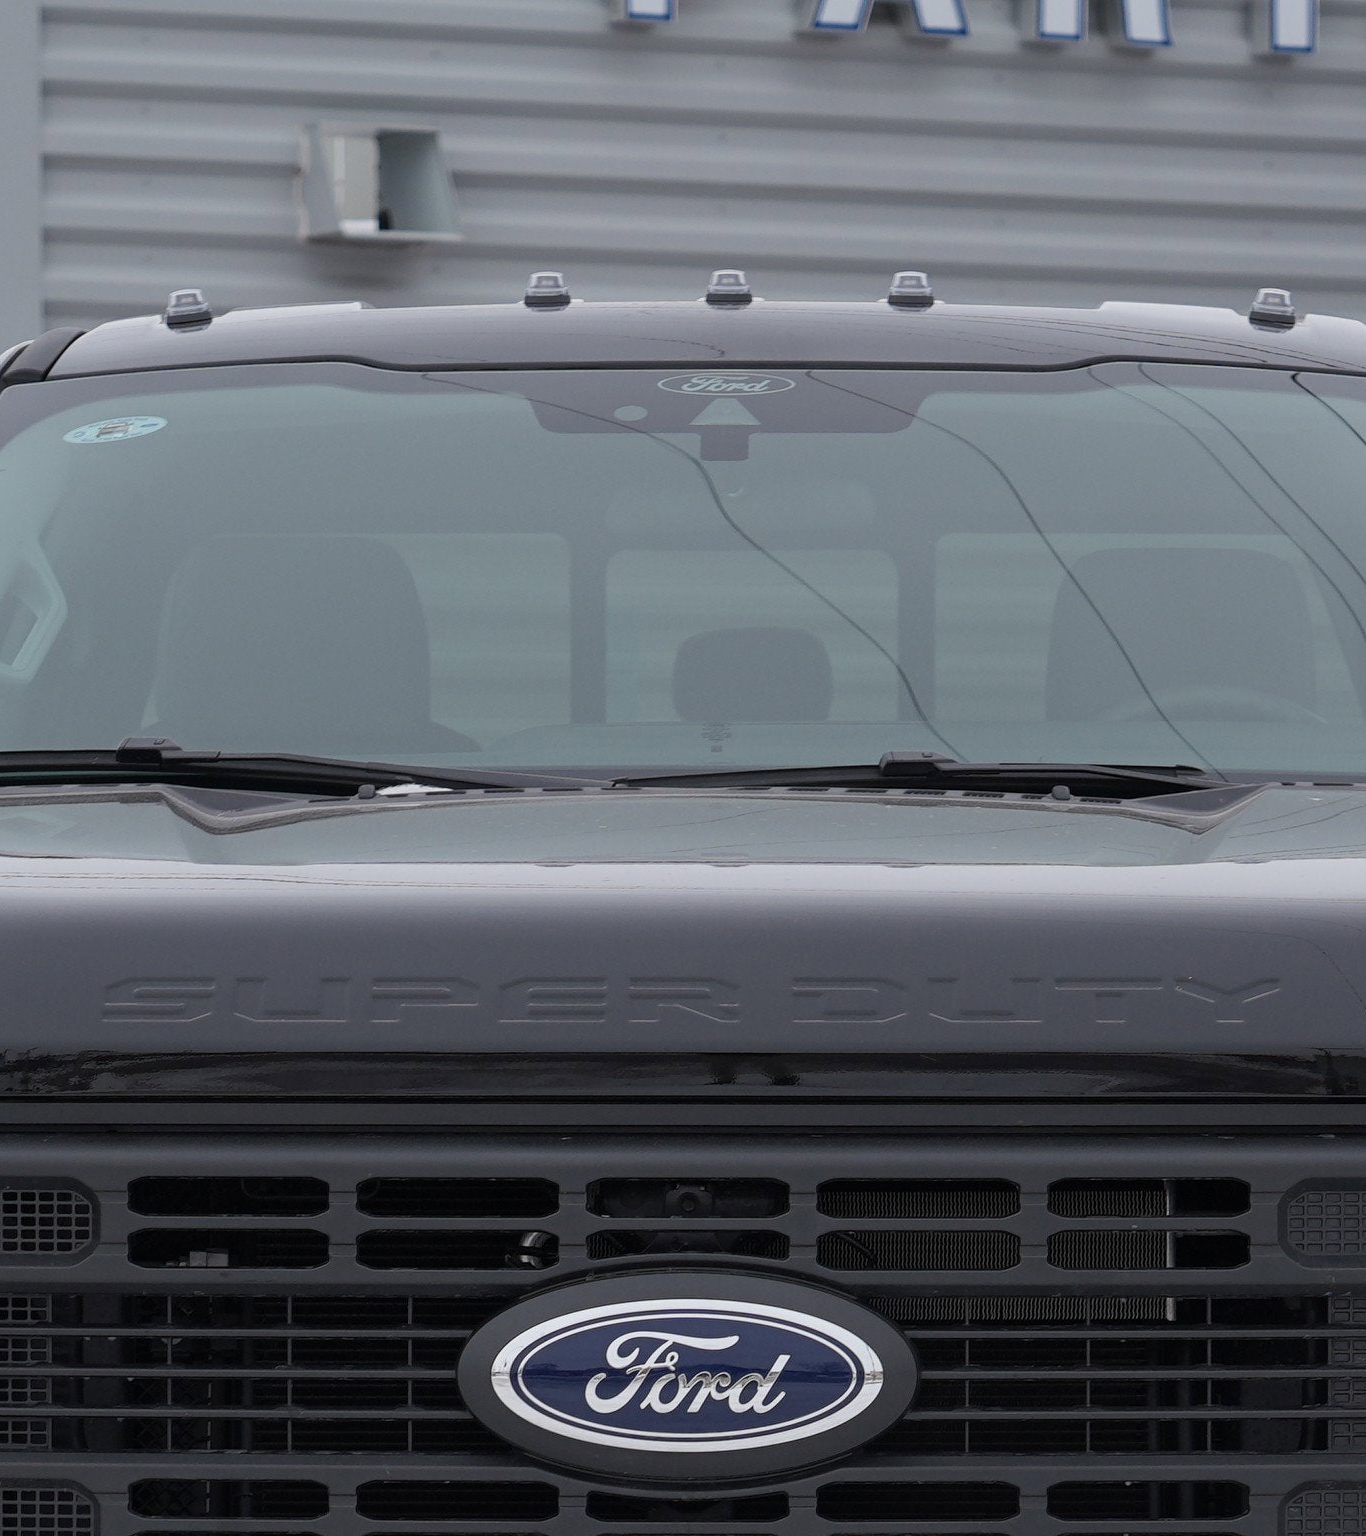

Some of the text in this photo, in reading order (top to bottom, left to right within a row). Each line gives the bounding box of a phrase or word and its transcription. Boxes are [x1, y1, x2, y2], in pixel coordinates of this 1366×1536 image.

[681, 374, 770, 393] Ford
[101, 976, 1281, 1023] SUPER DUTY
[584, 1330, 792, 1414] Ford
